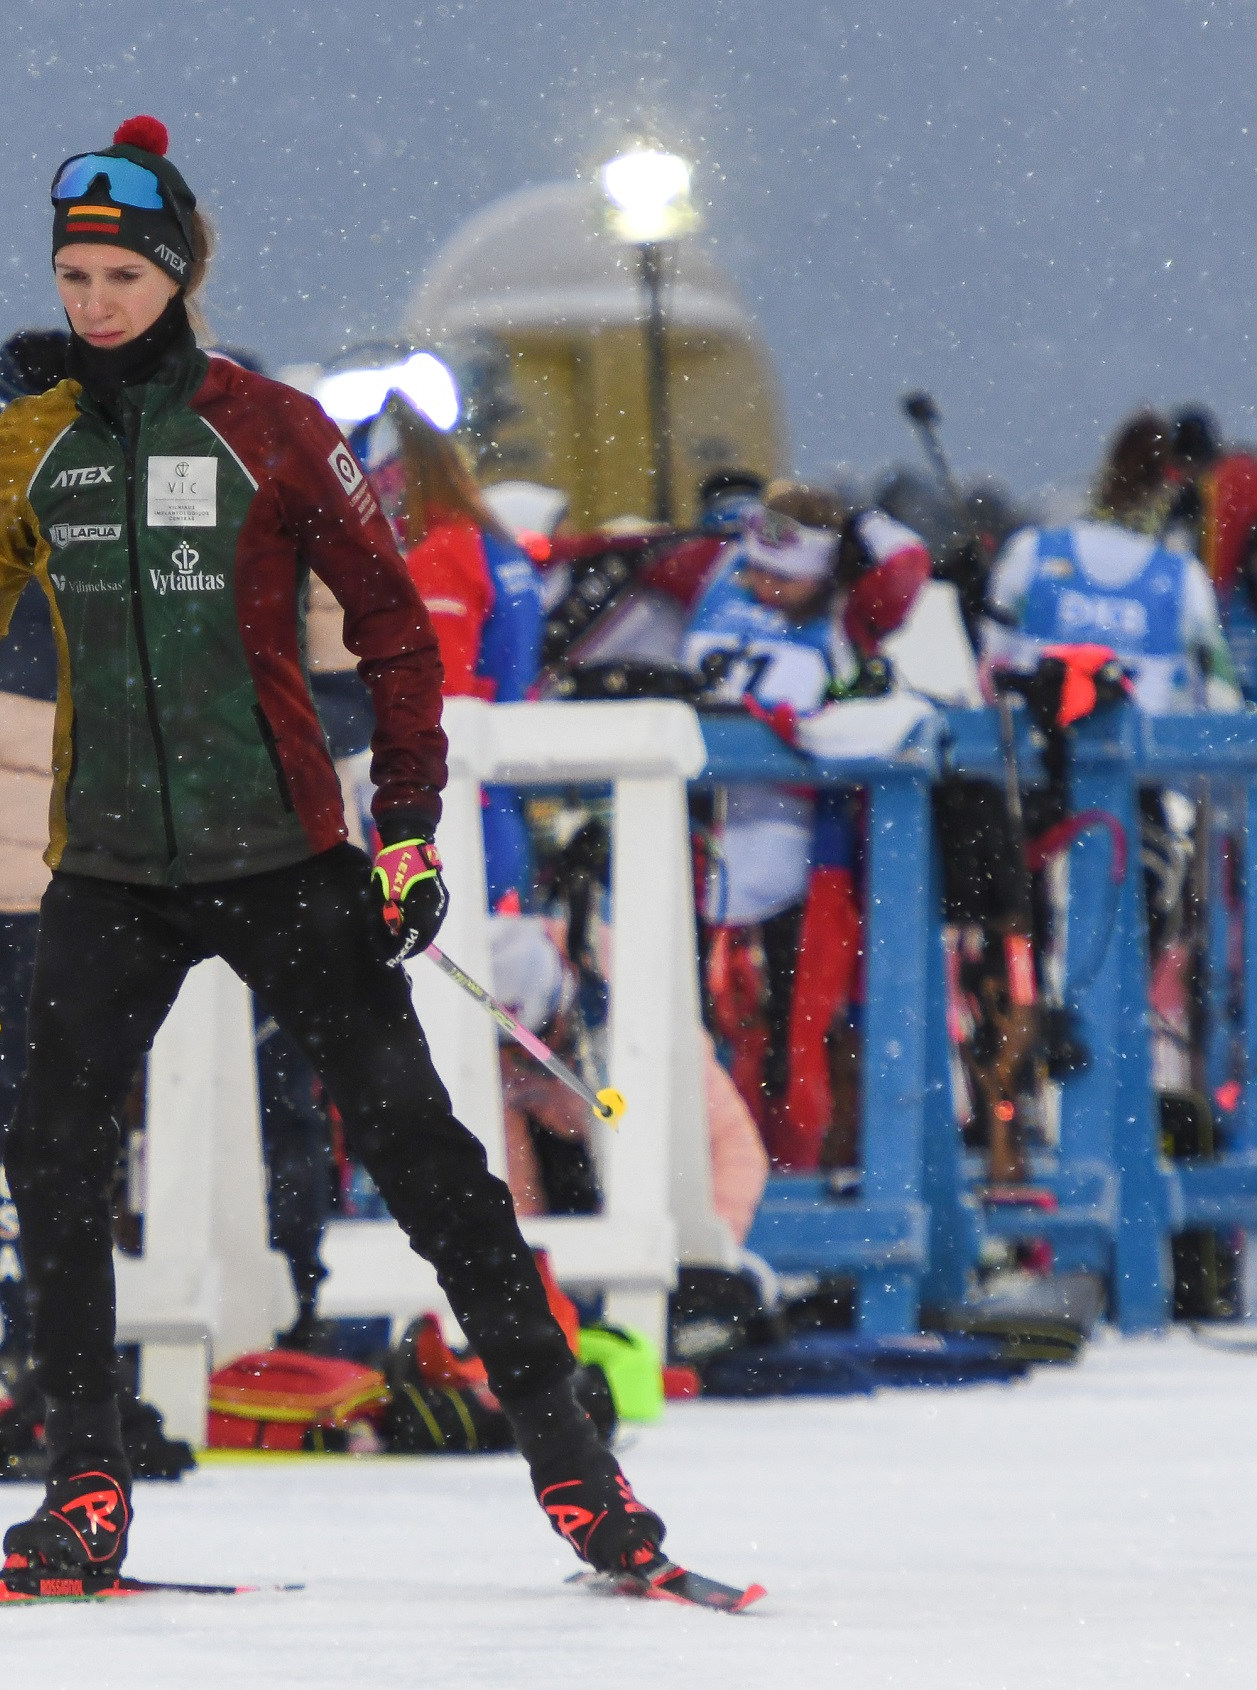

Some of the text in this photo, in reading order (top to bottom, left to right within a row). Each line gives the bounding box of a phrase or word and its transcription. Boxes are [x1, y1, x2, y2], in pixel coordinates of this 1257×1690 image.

[154, 244, 187, 275] ATEX
[49, 465, 116, 489] ATEX
[70, 527, 117, 538] LAPUA
[148, 568, 226, 596] Vytautas
[392, 851, 413, 894] LEKI
